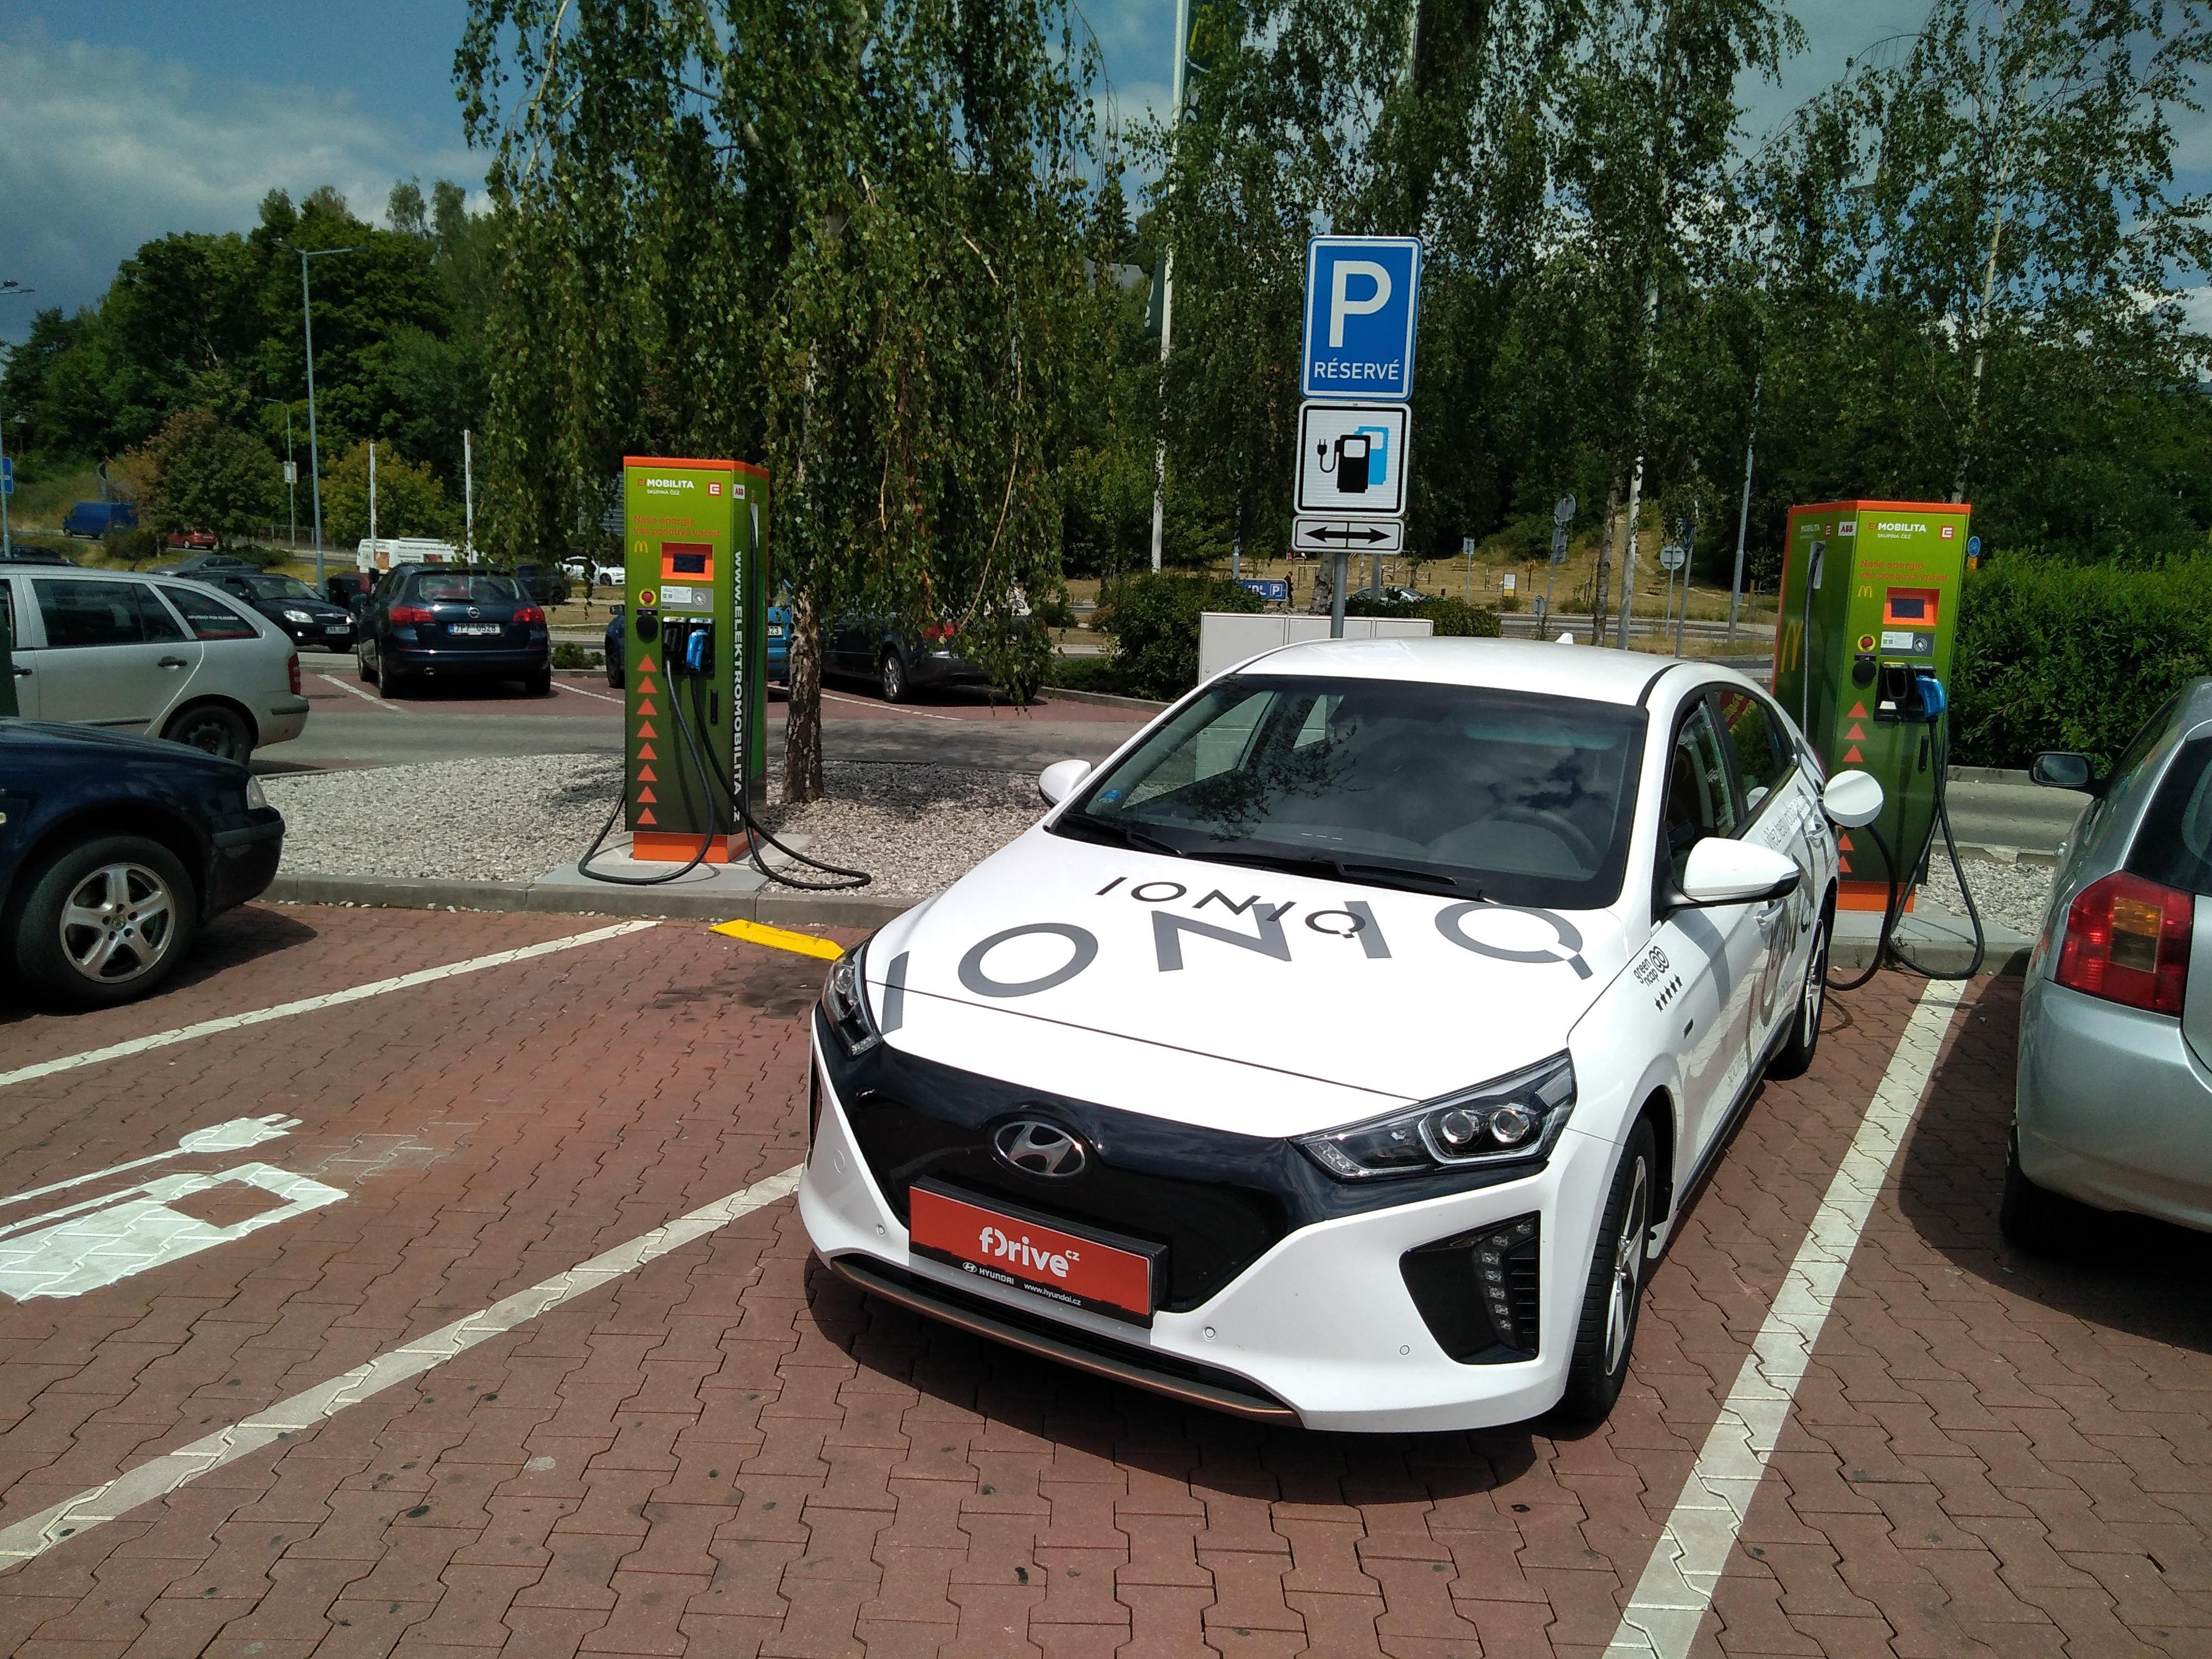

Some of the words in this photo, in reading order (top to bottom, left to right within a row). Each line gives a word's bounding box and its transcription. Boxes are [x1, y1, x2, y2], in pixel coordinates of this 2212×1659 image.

[1329, 260, 1391, 348] P
[1313, 358, 1400, 380] RÉSERVÉ
[734, 487, 744, 496] ABB
[659, 517, 696, 526] energie
[1887, 562, 1923, 570] energie
[456, 624, 470, 632] 7P7
[476, 624, 496, 632] 0528
[734, 551, 743, 823] www.ELEKTROMOBILITAz
[1095, 877, 1366, 938] IONIQ
[881, 900, 1594, 1036] IONIQ
[1633, 958, 1652, 984] green
[1643, 968, 1660, 987] ncap
[979, 1267, 1014, 1285] HYUNDAI
[1024, 1283, 1081, 1306] www.hyundai.cz
